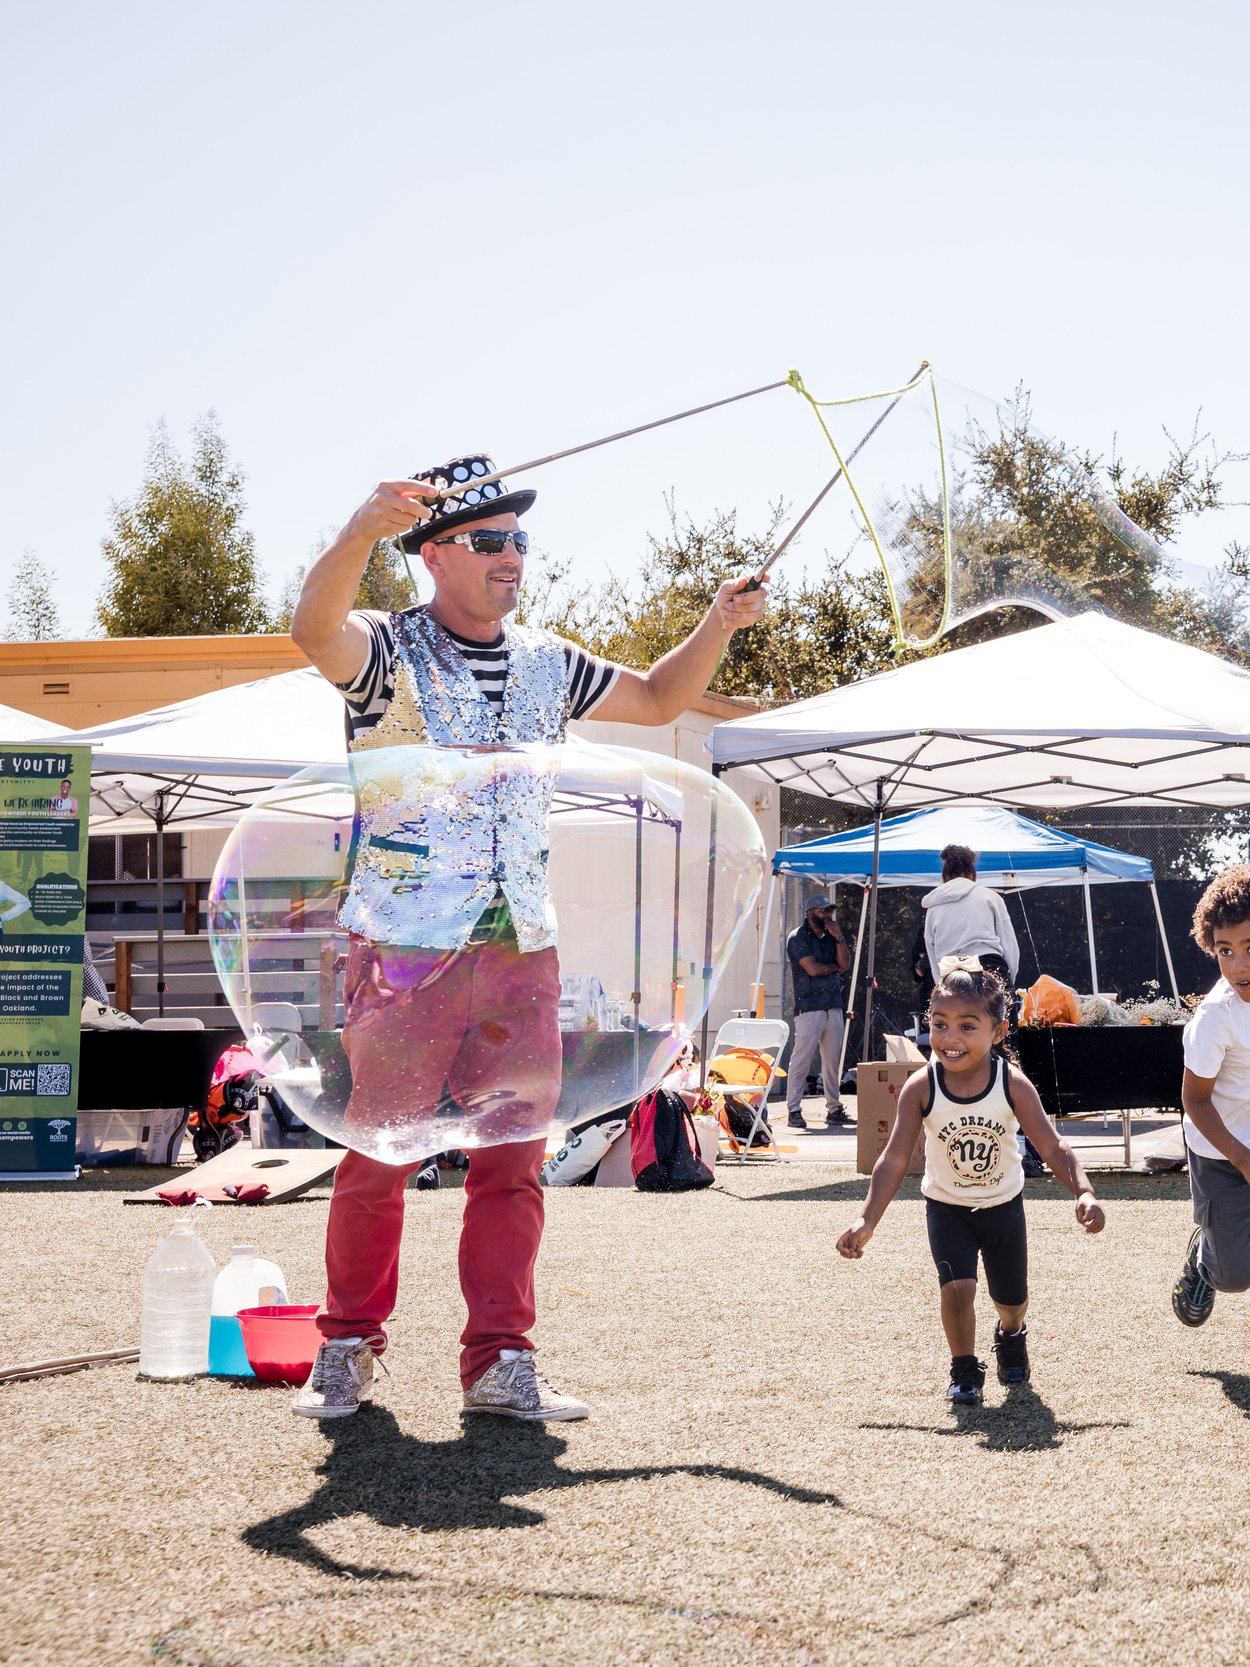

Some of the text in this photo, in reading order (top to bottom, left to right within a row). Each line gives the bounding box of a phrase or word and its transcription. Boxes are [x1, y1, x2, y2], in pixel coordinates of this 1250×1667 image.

[13, 757, 66, 774] YOUTH
[32, 798, 63, 809] HIRING
[0, 945, 70, 954] YOUTH PROJECT?
[9, 1079, 34, 1090] ME!
[938, 1116, 1006, 1142] NYC DREAMY
